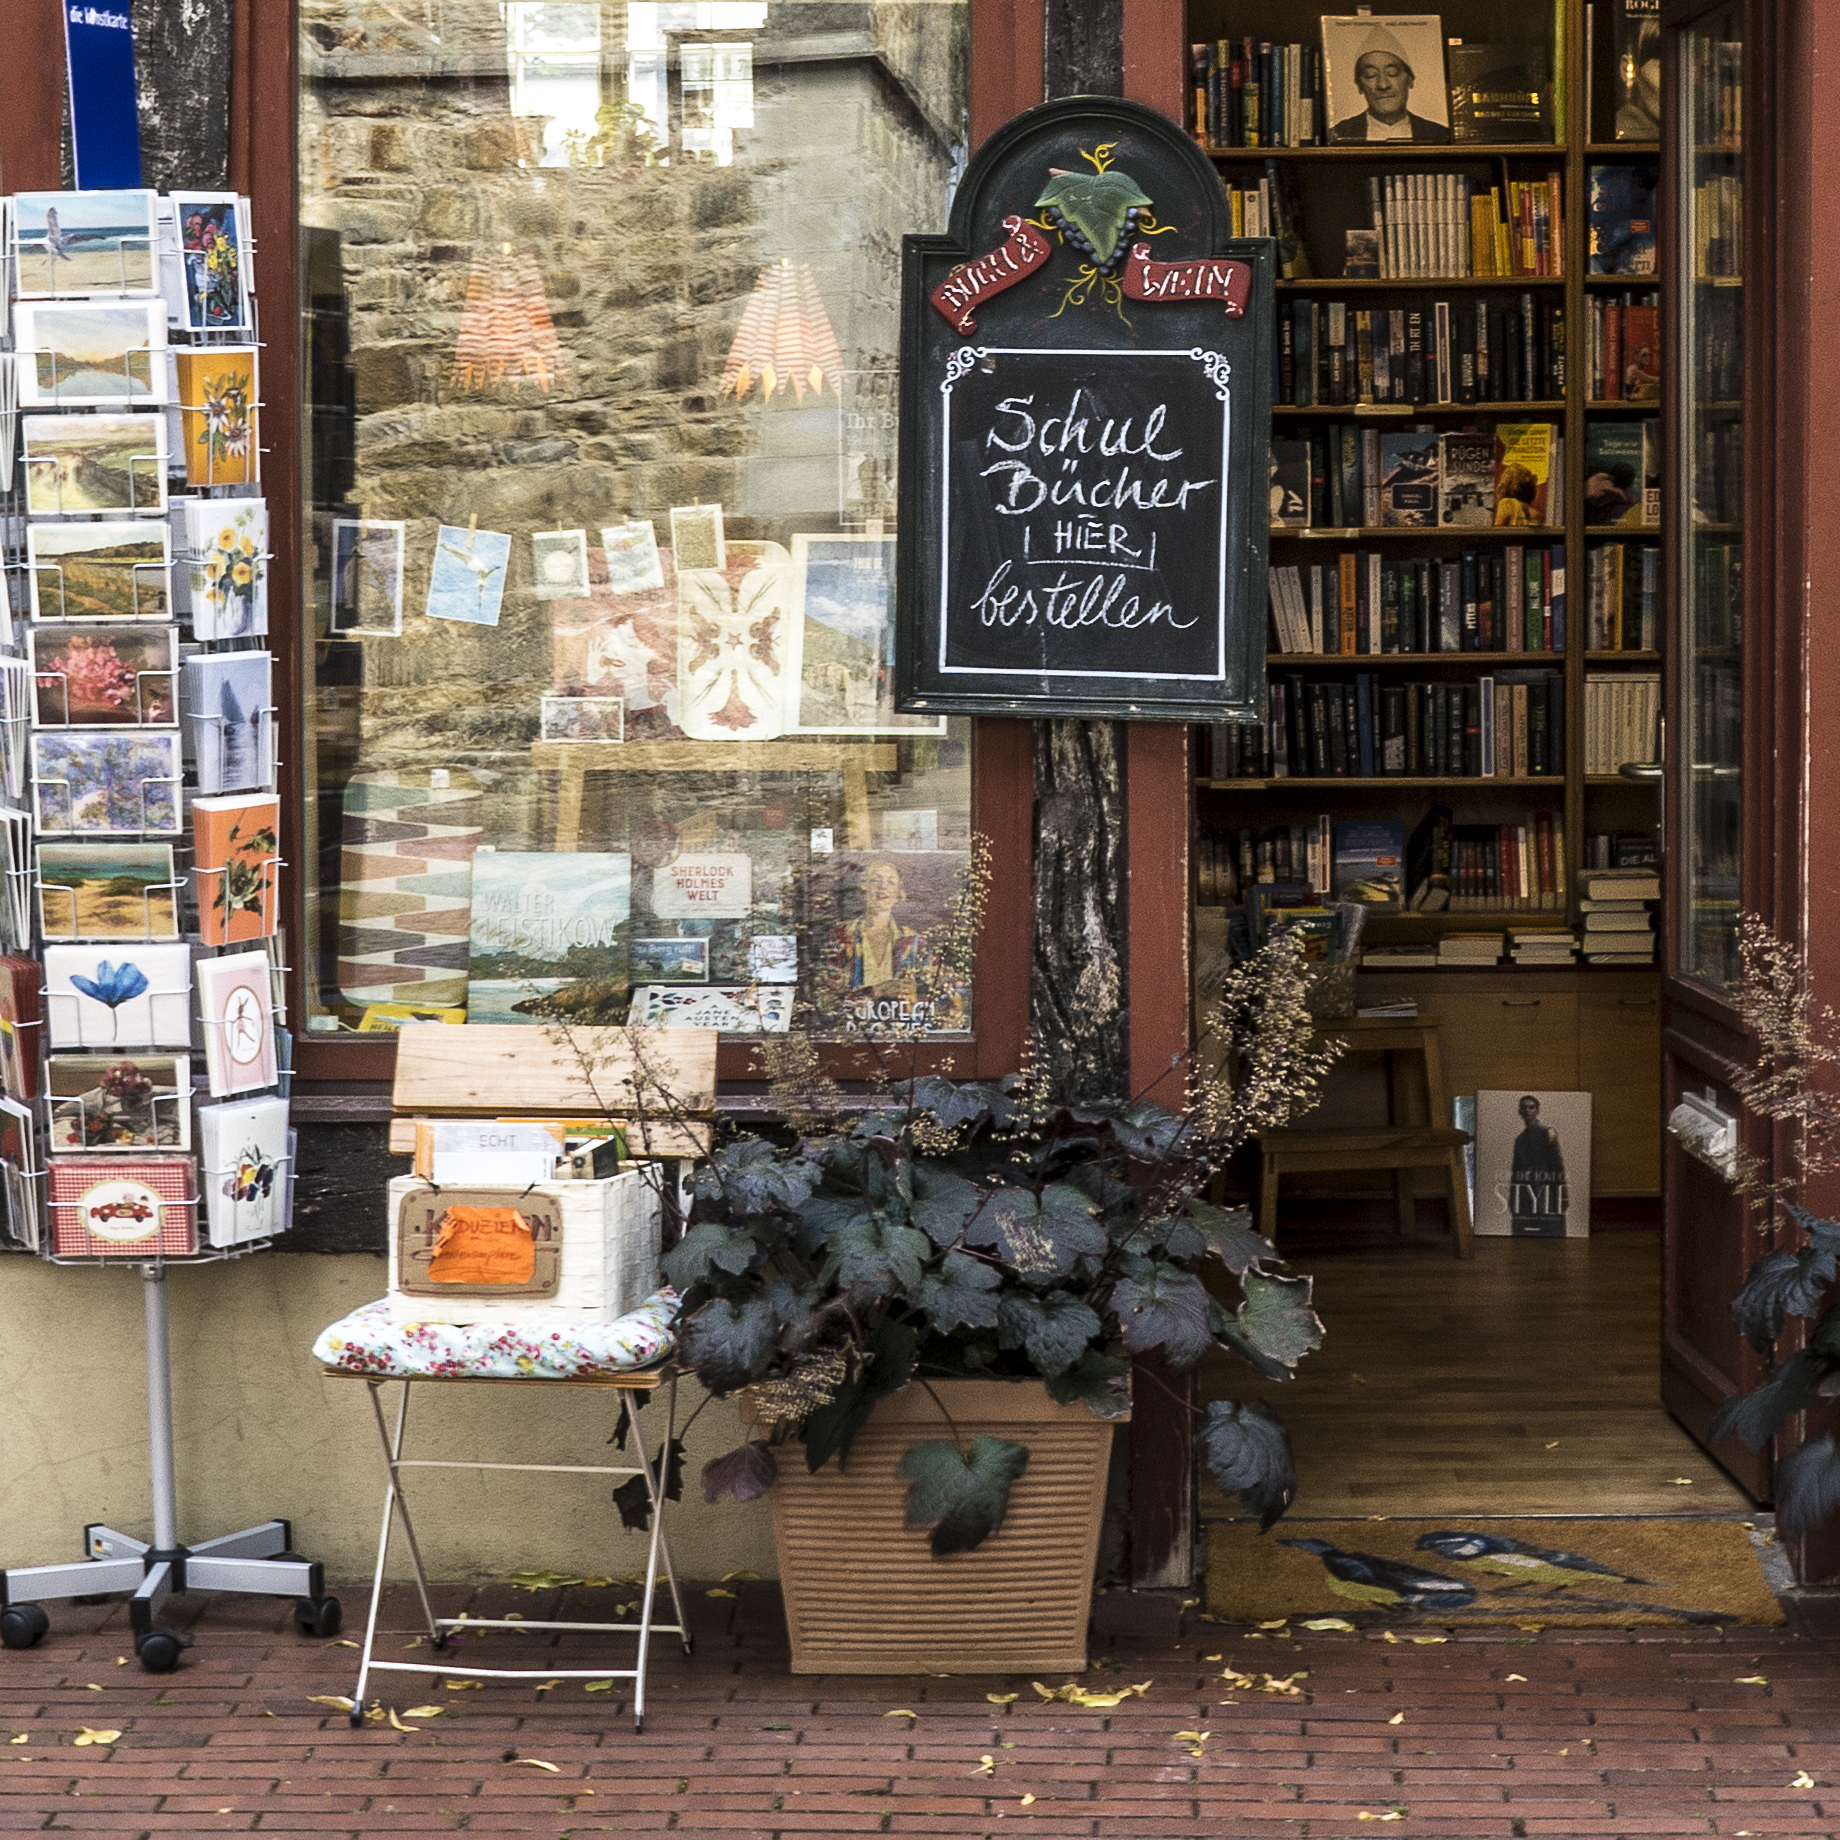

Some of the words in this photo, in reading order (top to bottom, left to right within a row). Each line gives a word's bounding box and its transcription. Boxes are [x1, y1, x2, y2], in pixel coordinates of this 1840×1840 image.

[986, 388, 1184, 463] Schul
[979, 462, 1218, 515] Bücher
[1055, 514, 1142, 557] HIER
[971, 560, 1200, 630] bestellen
[671, 866, 734, 877] SHERLOCK
[687, 890, 719, 901] WELT
[479, 1134, 517, 1148] ECHT
[1494, 1182, 1570, 1215] STYLE
